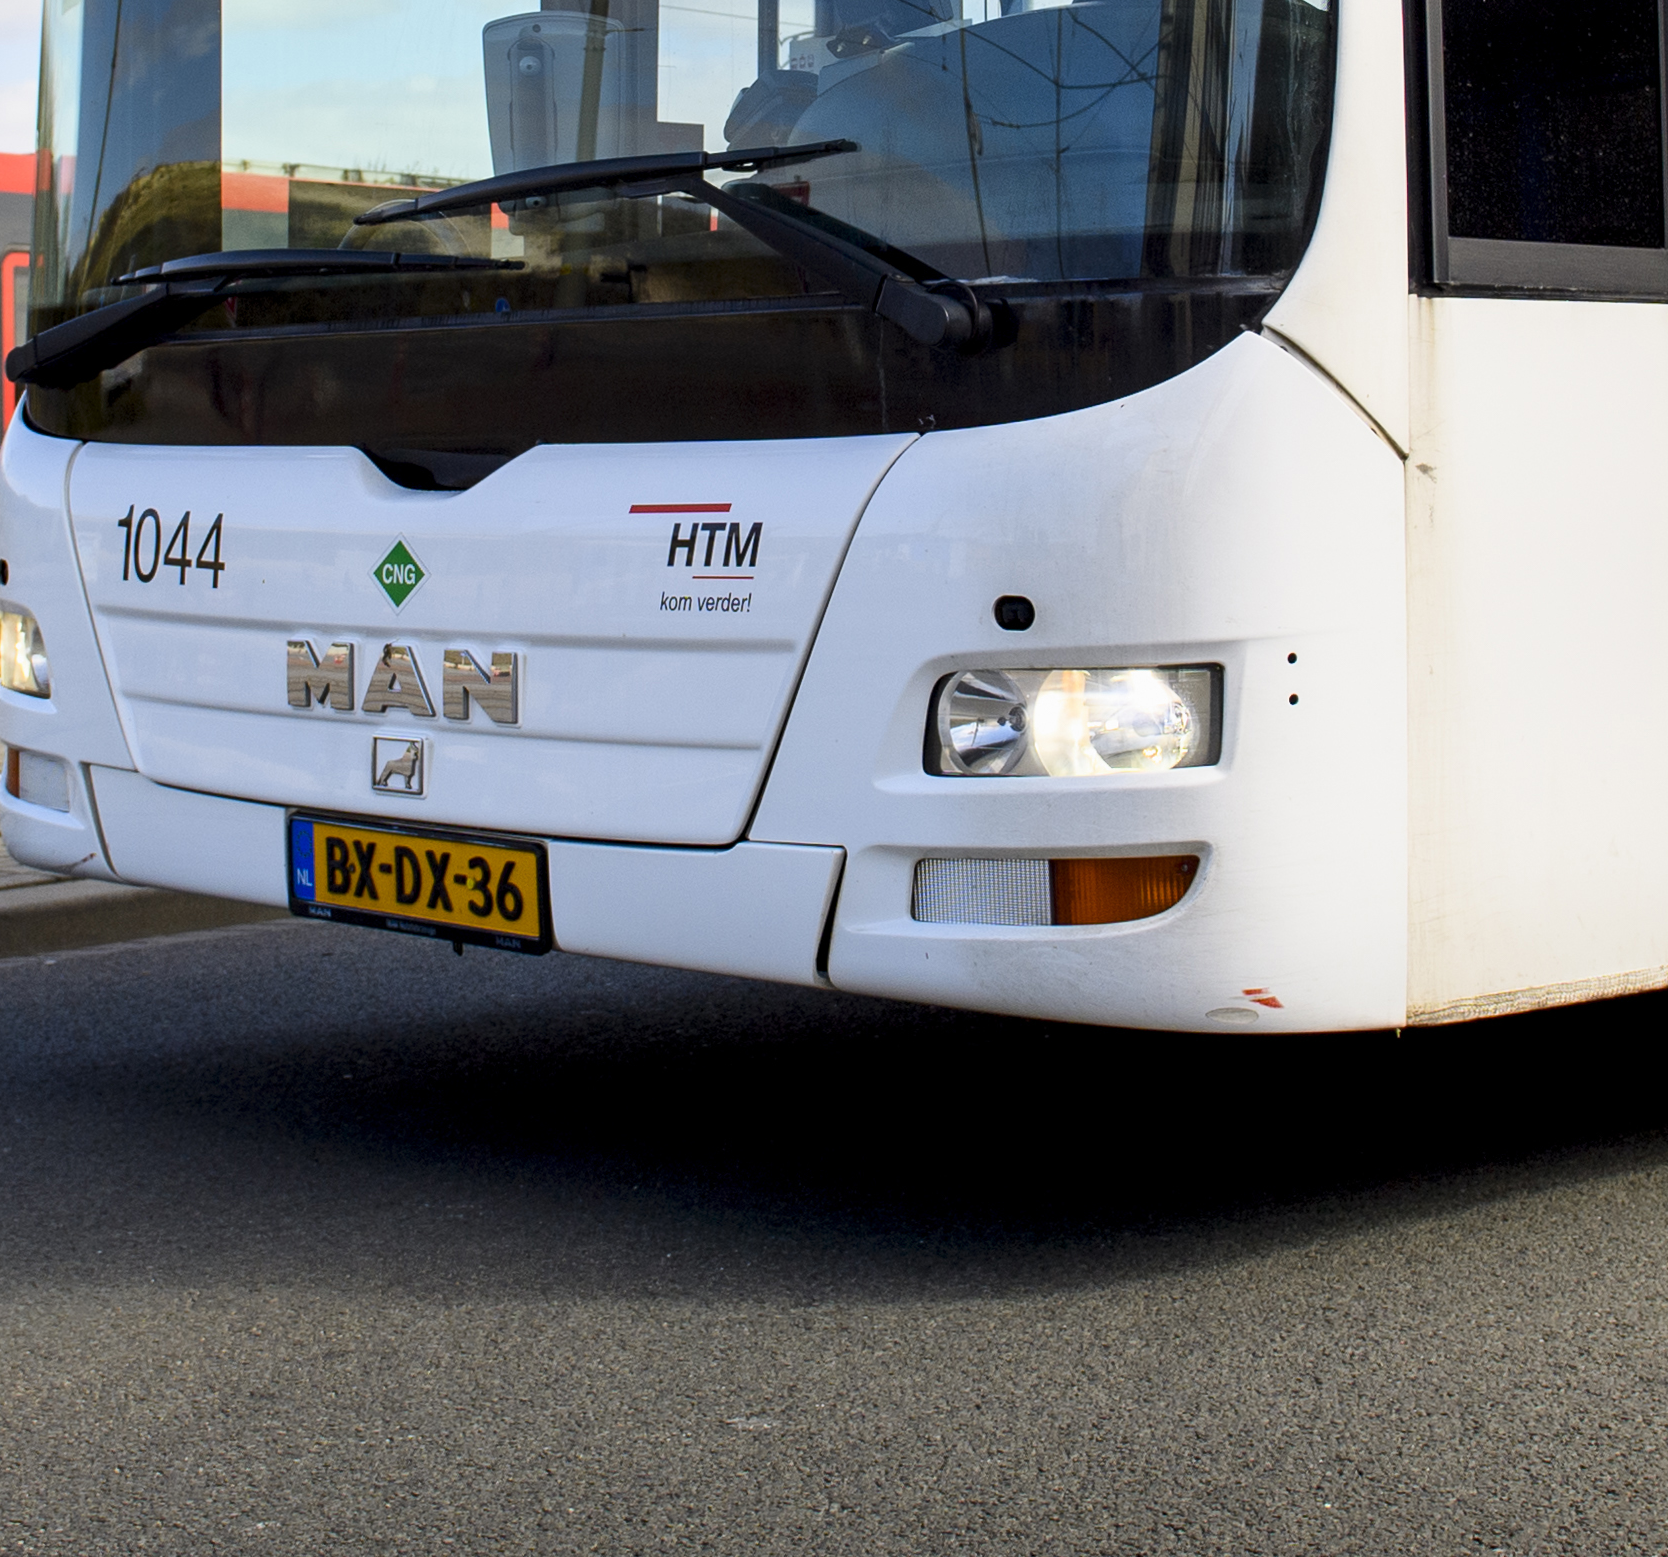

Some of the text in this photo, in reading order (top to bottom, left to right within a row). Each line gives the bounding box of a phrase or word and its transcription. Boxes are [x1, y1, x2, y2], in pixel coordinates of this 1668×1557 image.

[118, 504, 225, 589] 1044
[667, 522, 763, 567] HTM
[382, 563, 415, 585] CNG
[660, 591, 752, 612] kom verder!
[286, 639, 519, 725] MAN
[297, 868, 313, 886] NL
[326, 836, 523, 921] BX-DX-36
